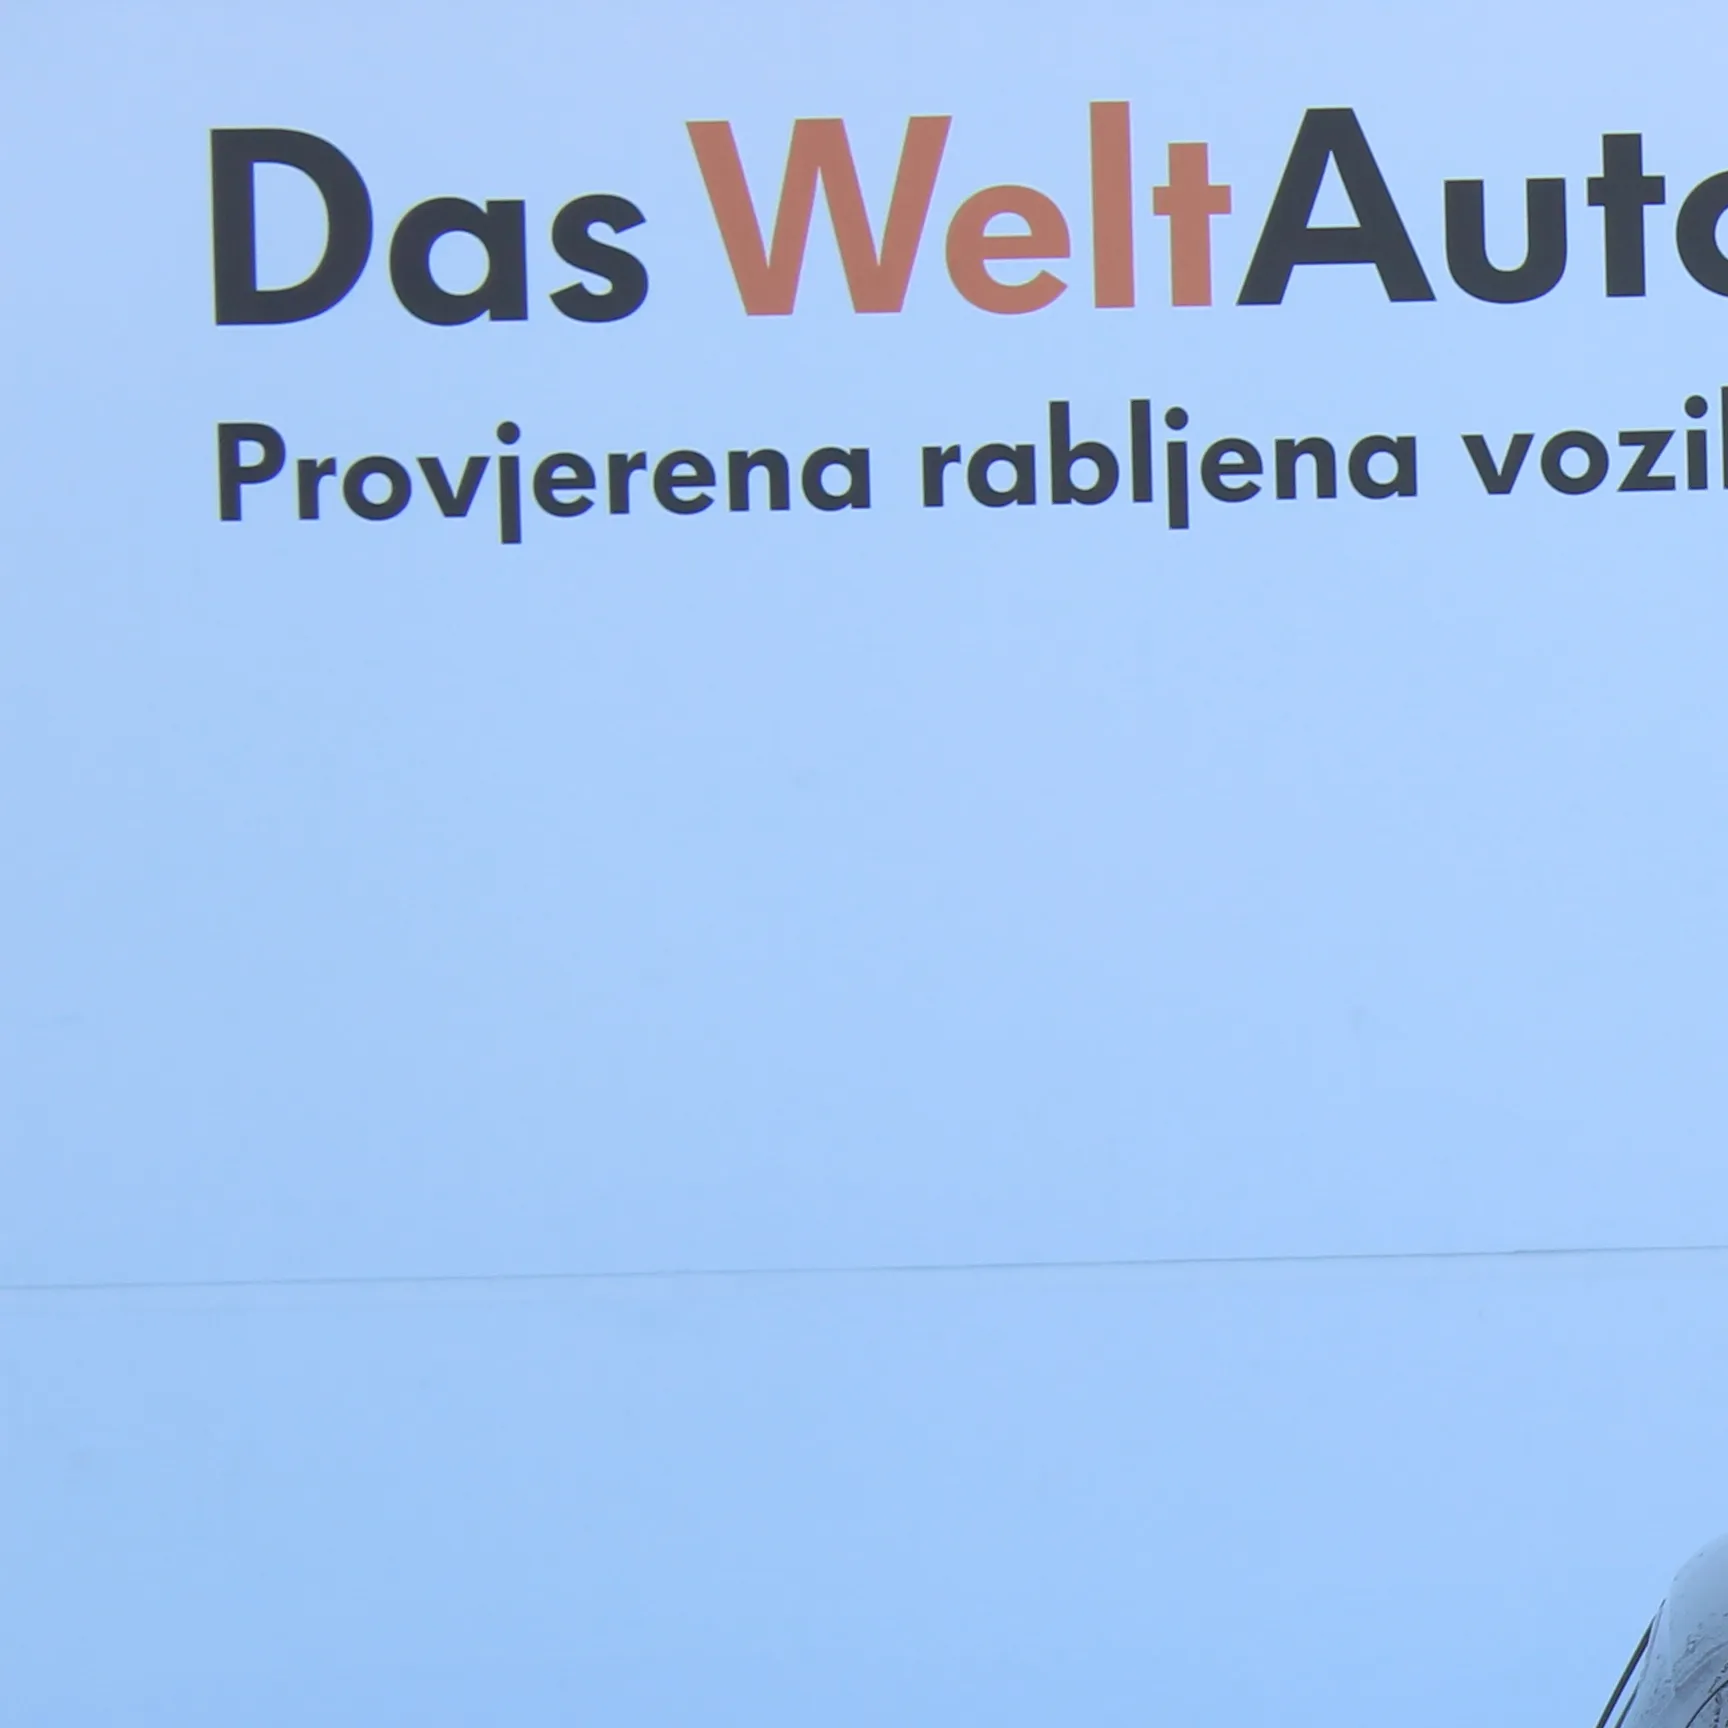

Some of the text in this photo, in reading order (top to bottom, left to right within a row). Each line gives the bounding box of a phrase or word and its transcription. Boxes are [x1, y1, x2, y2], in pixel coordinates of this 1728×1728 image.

[209, 127, 648, 326] Das
[216, 420, 871, 545] Provjerena
[921, 398, 1417, 530] rabljena
